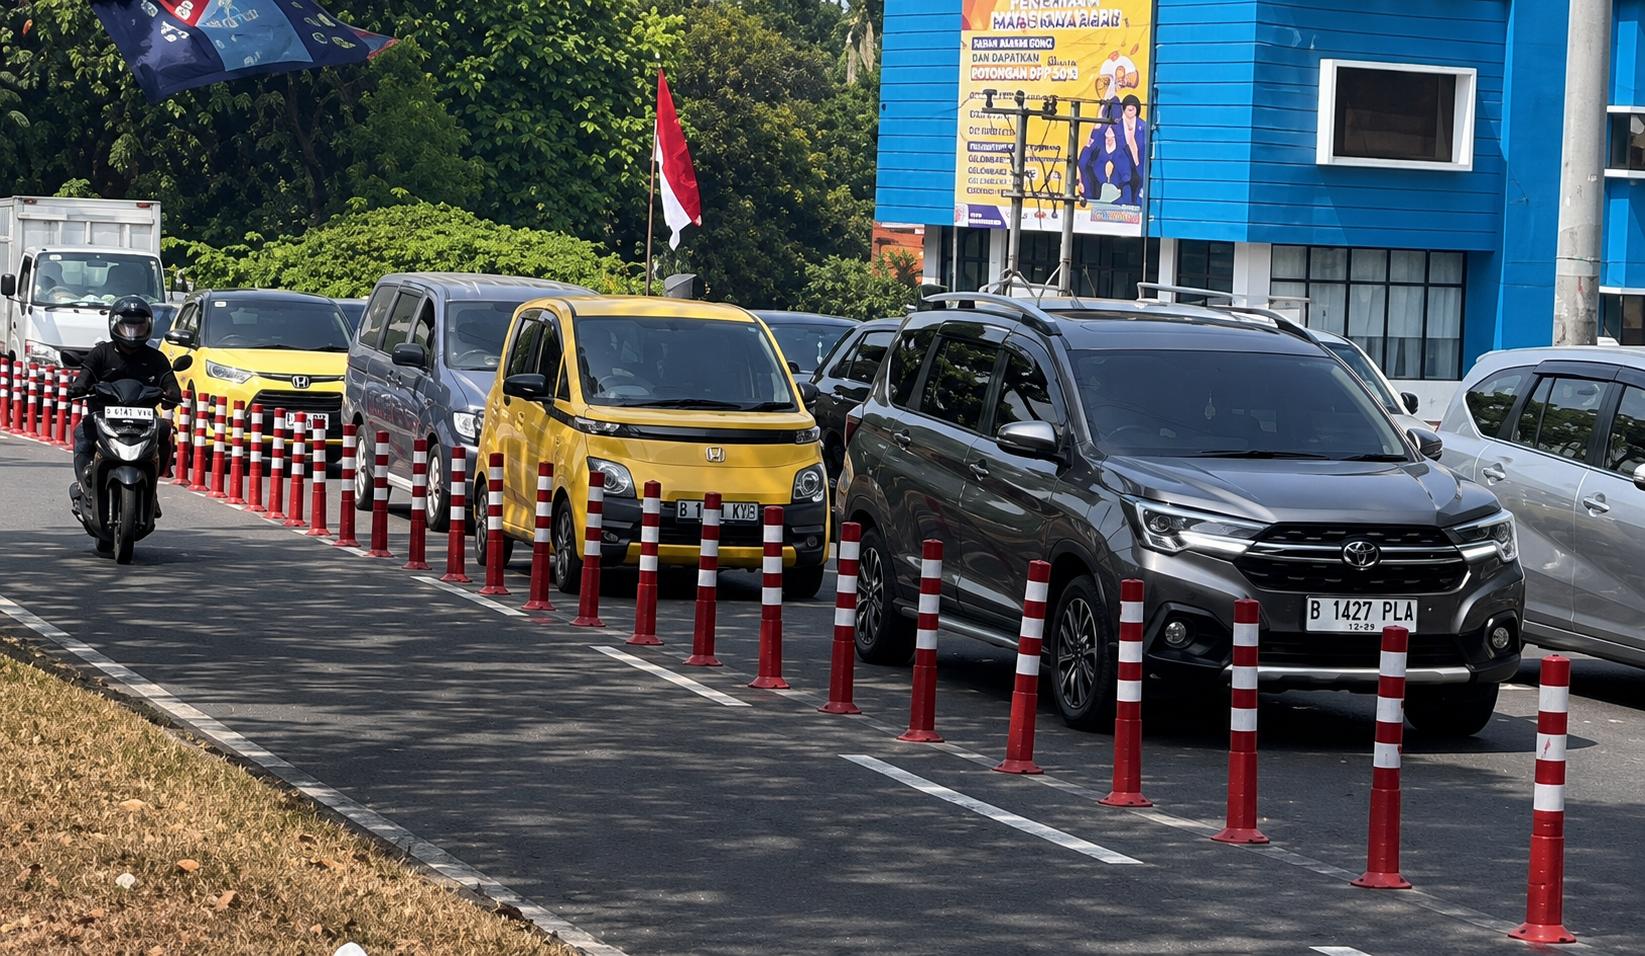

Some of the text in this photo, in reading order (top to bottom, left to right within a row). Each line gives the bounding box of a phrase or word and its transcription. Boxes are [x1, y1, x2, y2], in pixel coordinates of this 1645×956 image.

[972, 53, 990, 63] DAN
[992, 52, 1040, 63] DAPATKAN
[971, 66, 1028, 80] POTONGAN
[679, 502, 687, 517] B
[1310, 600, 1413, 621] B 1427 PLA
[1348, 623, 1375, 631] 12-29
